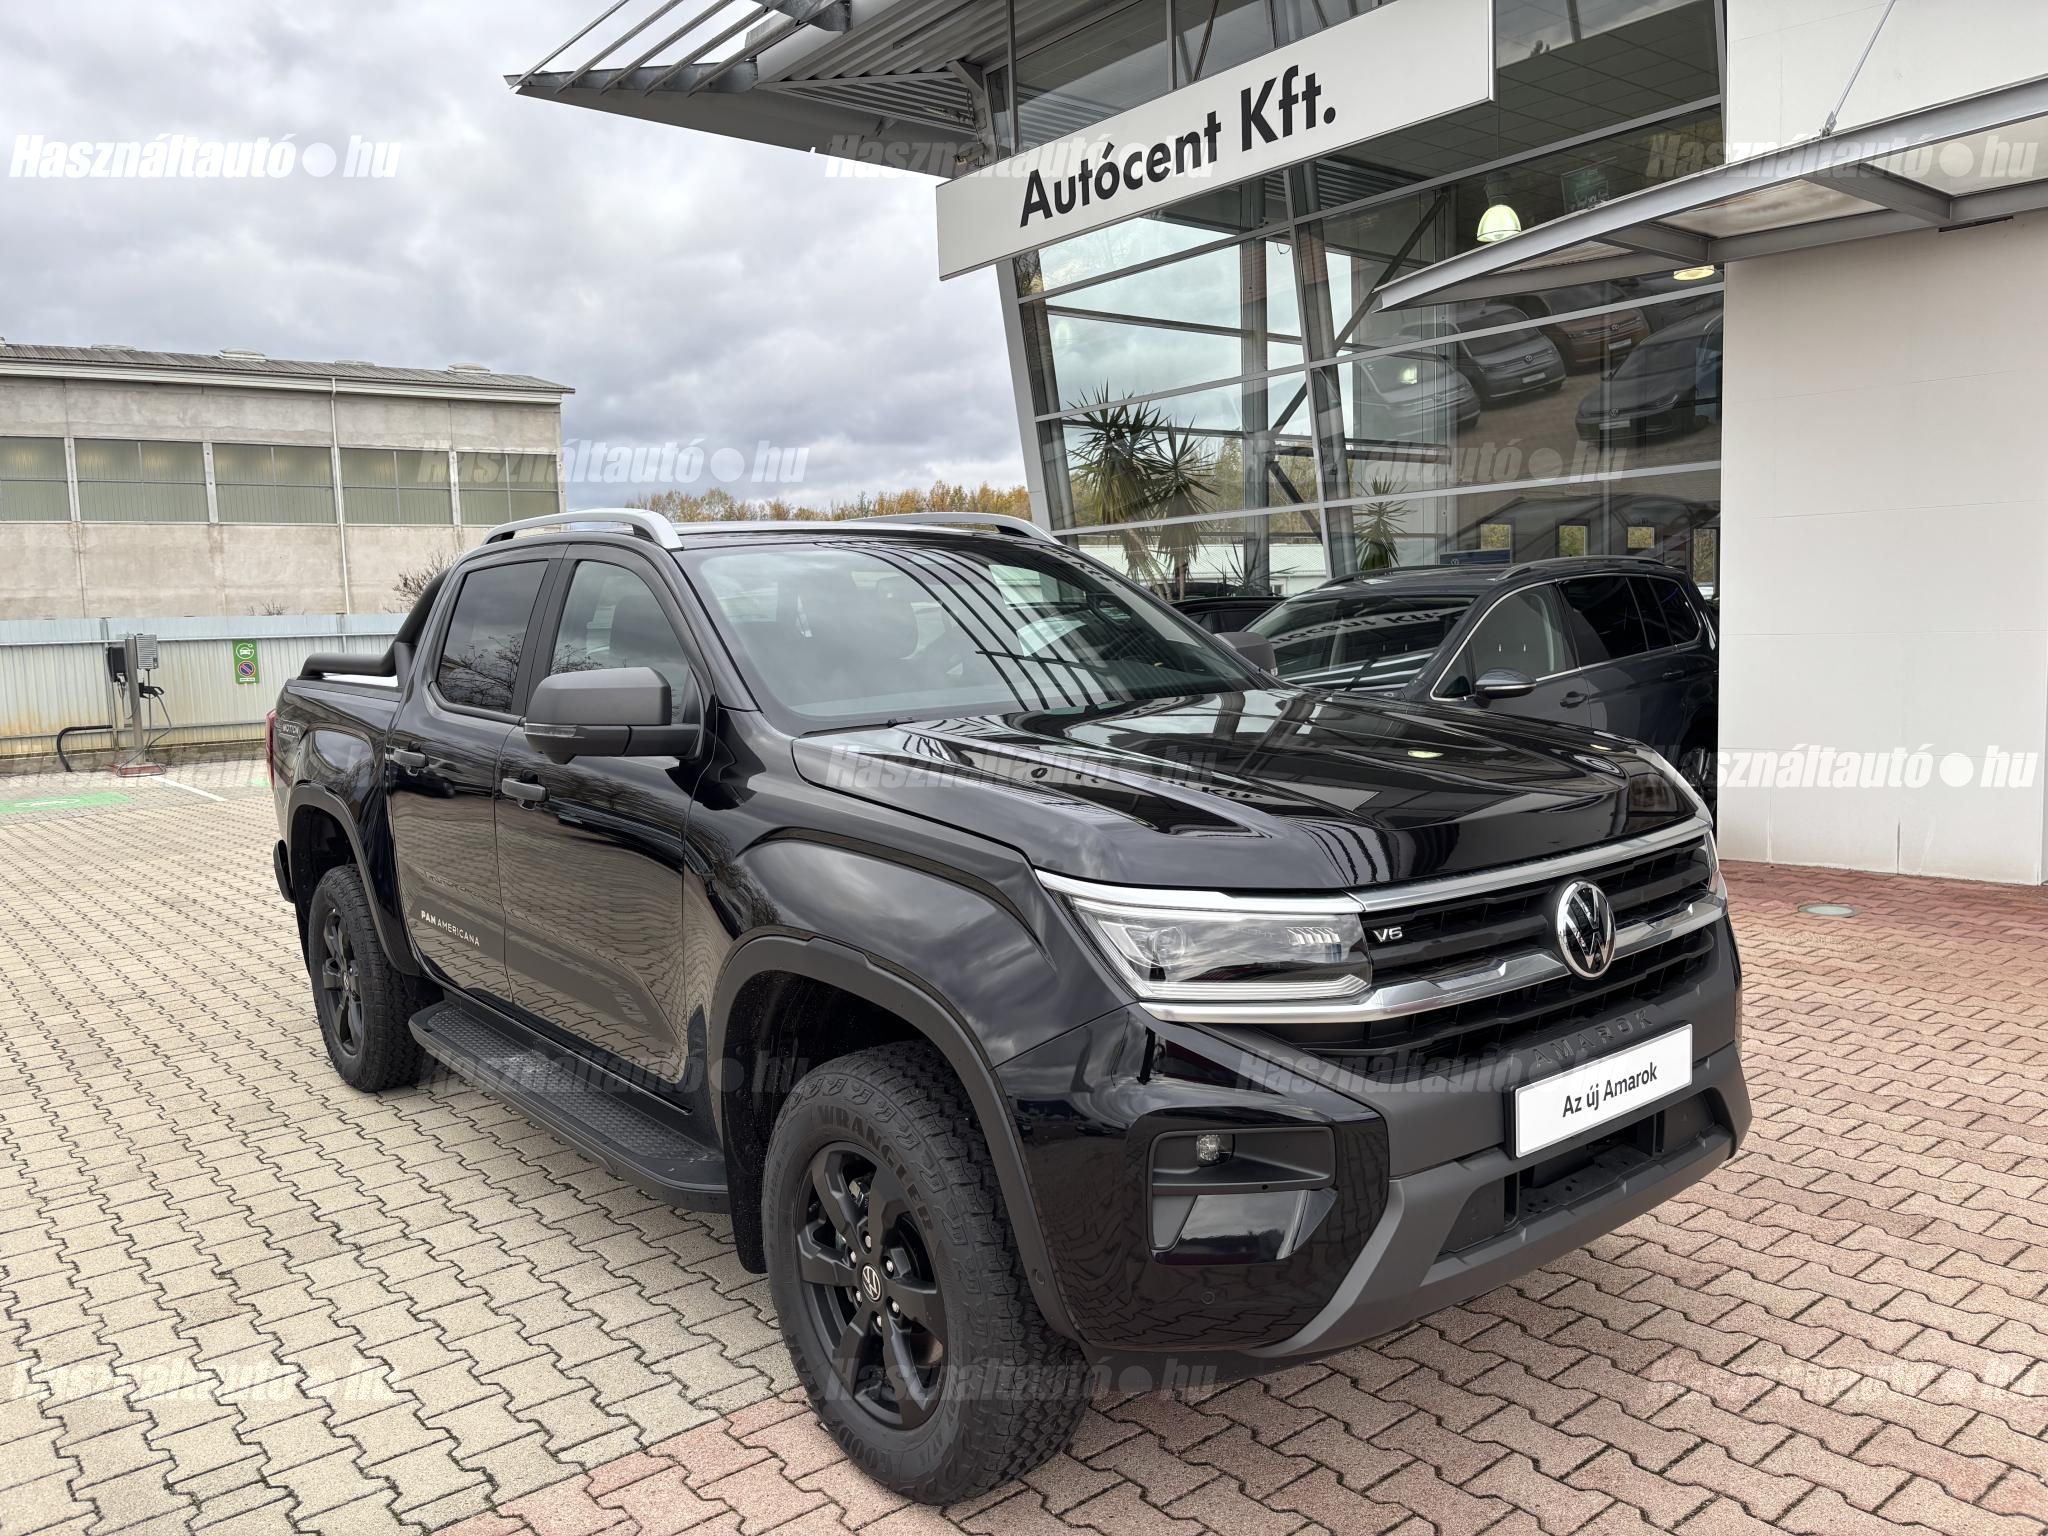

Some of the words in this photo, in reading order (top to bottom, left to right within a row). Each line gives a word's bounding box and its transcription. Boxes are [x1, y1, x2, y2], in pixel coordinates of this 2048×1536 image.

[1020, 110, 1221, 228] Autócent
[1241, 64, 1336, 152] Kft.
[420, 909, 437, 925] PAN
[437, 919, 480, 947] AMERICANA
[1373, 926, 1402, 942] V6
[1533, 1009, 1654, 1068] AMAROK
[1562, 1095, 1582, 1118] Az
[1586, 1083, 1600, 1111] új
[1603, 1061, 1658, 1101] Amarok
